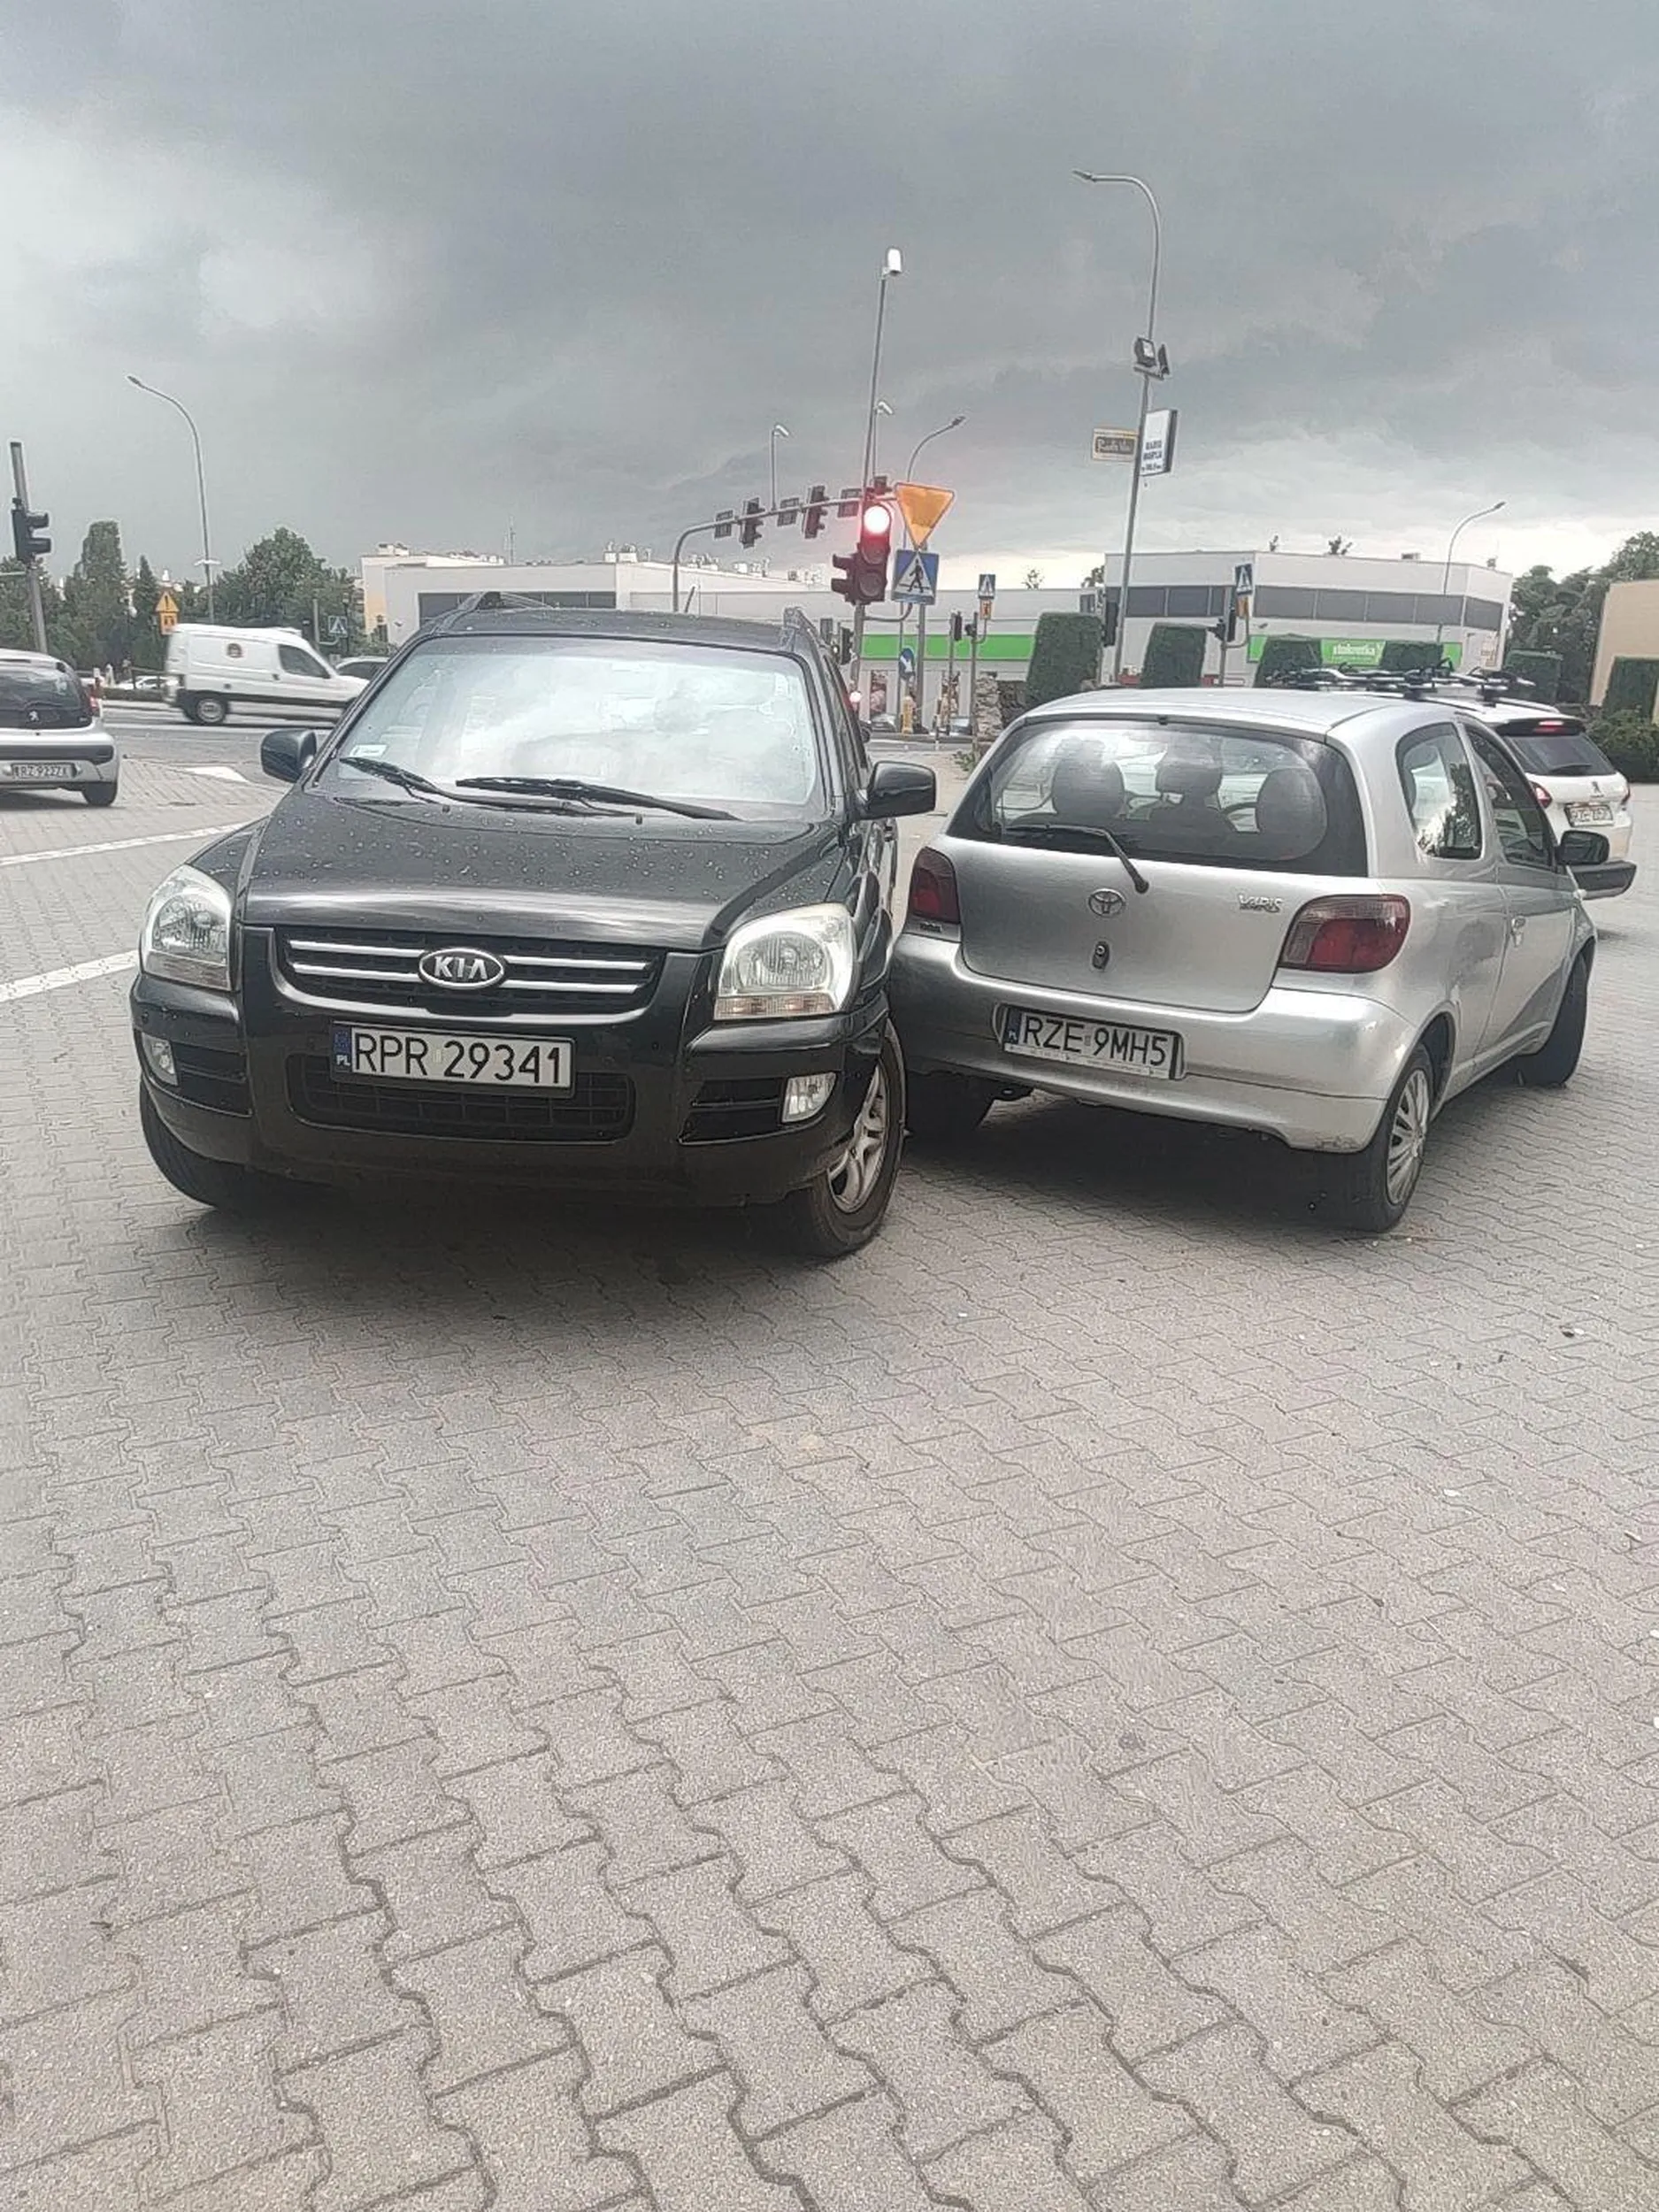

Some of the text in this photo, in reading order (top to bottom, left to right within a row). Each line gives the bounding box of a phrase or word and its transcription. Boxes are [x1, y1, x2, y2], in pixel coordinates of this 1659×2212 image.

[434, 956, 488, 979] KIA
[355, 1033, 560, 1084] RPR 29341
[1023, 1018, 1085, 1053] RZE
[1093, 1027, 1168, 1066] 9MH5
